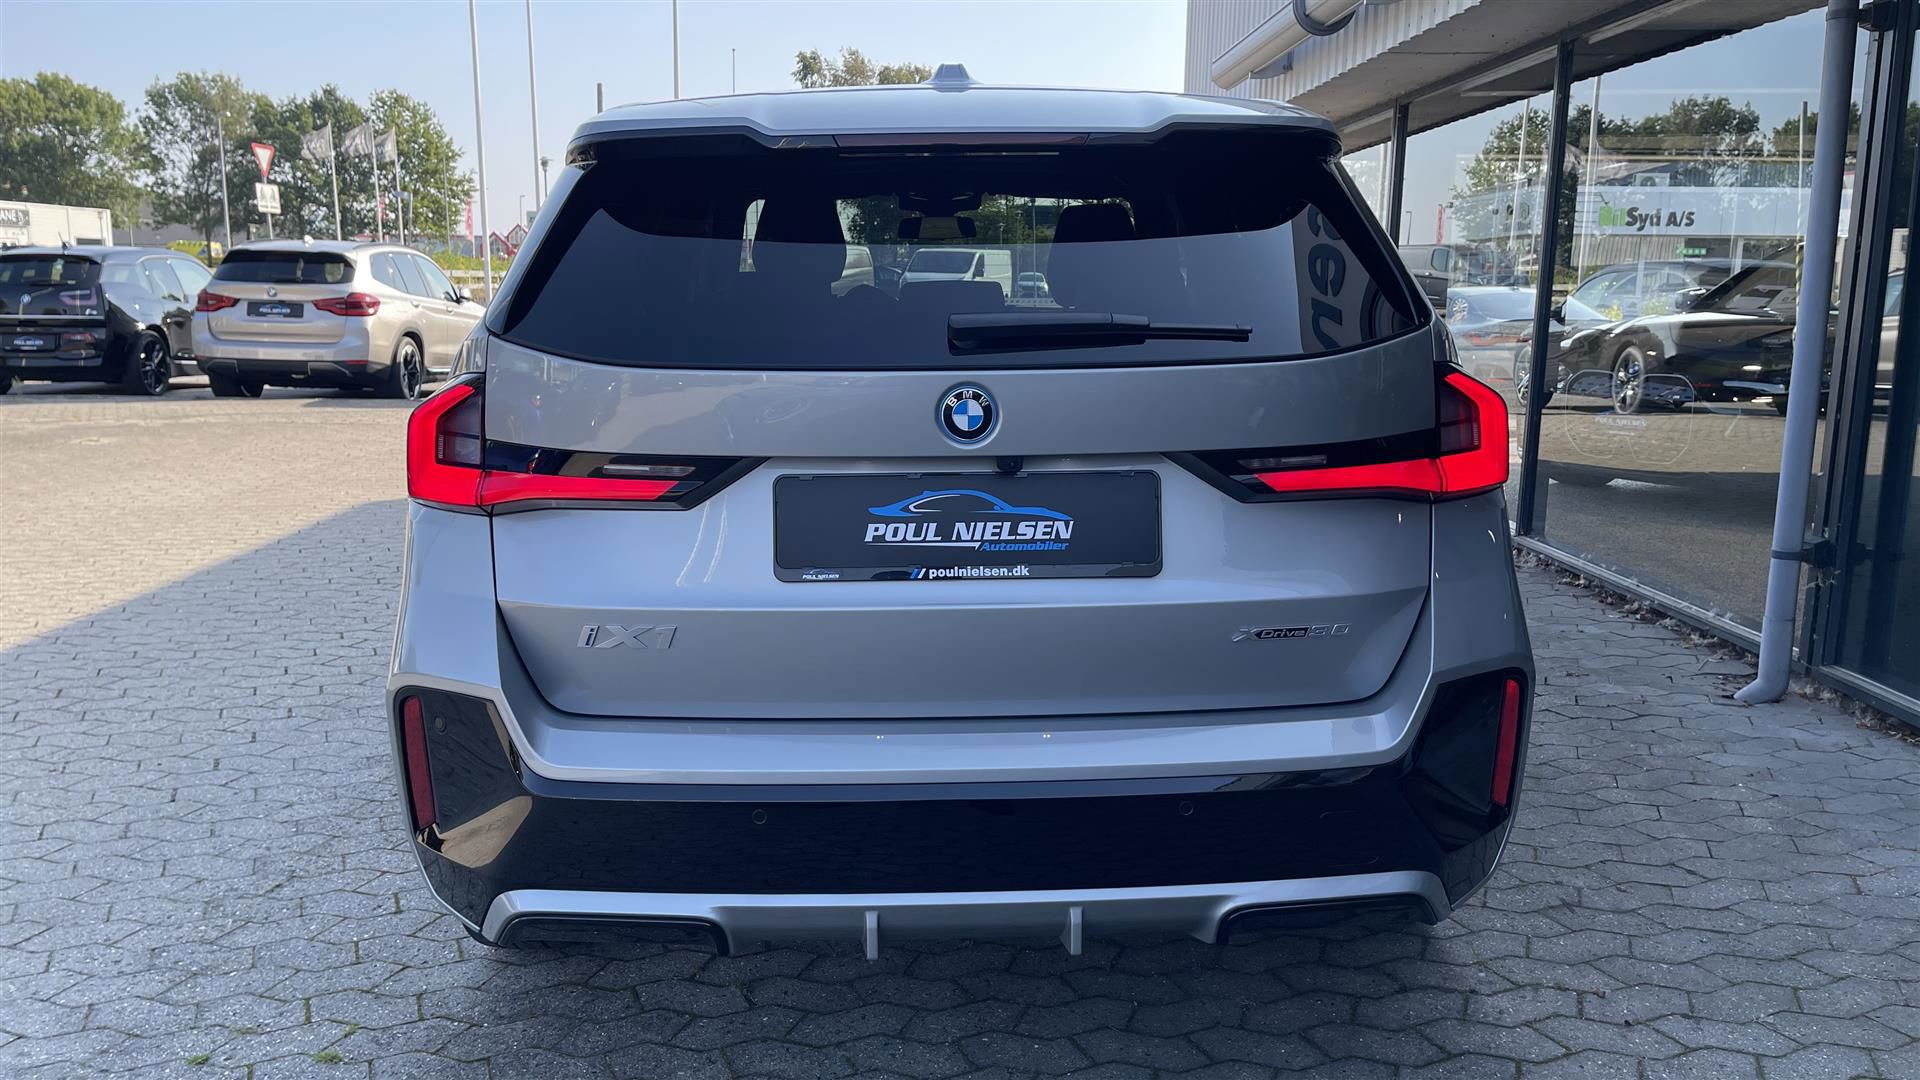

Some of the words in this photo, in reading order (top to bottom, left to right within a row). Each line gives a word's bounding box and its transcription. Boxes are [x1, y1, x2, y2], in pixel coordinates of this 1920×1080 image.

[1666, 210, 1696, 227] A/S
[947, 390, 990, 407] BMW
[864, 522, 942, 543] POUL
[952, 520, 1075, 541] NIELSEN
[980, 540, 1069, 552] Automobiler
[928, 565, 1030, 579] poulnielsen.dk
[576, 624, 678, 649] iX1
